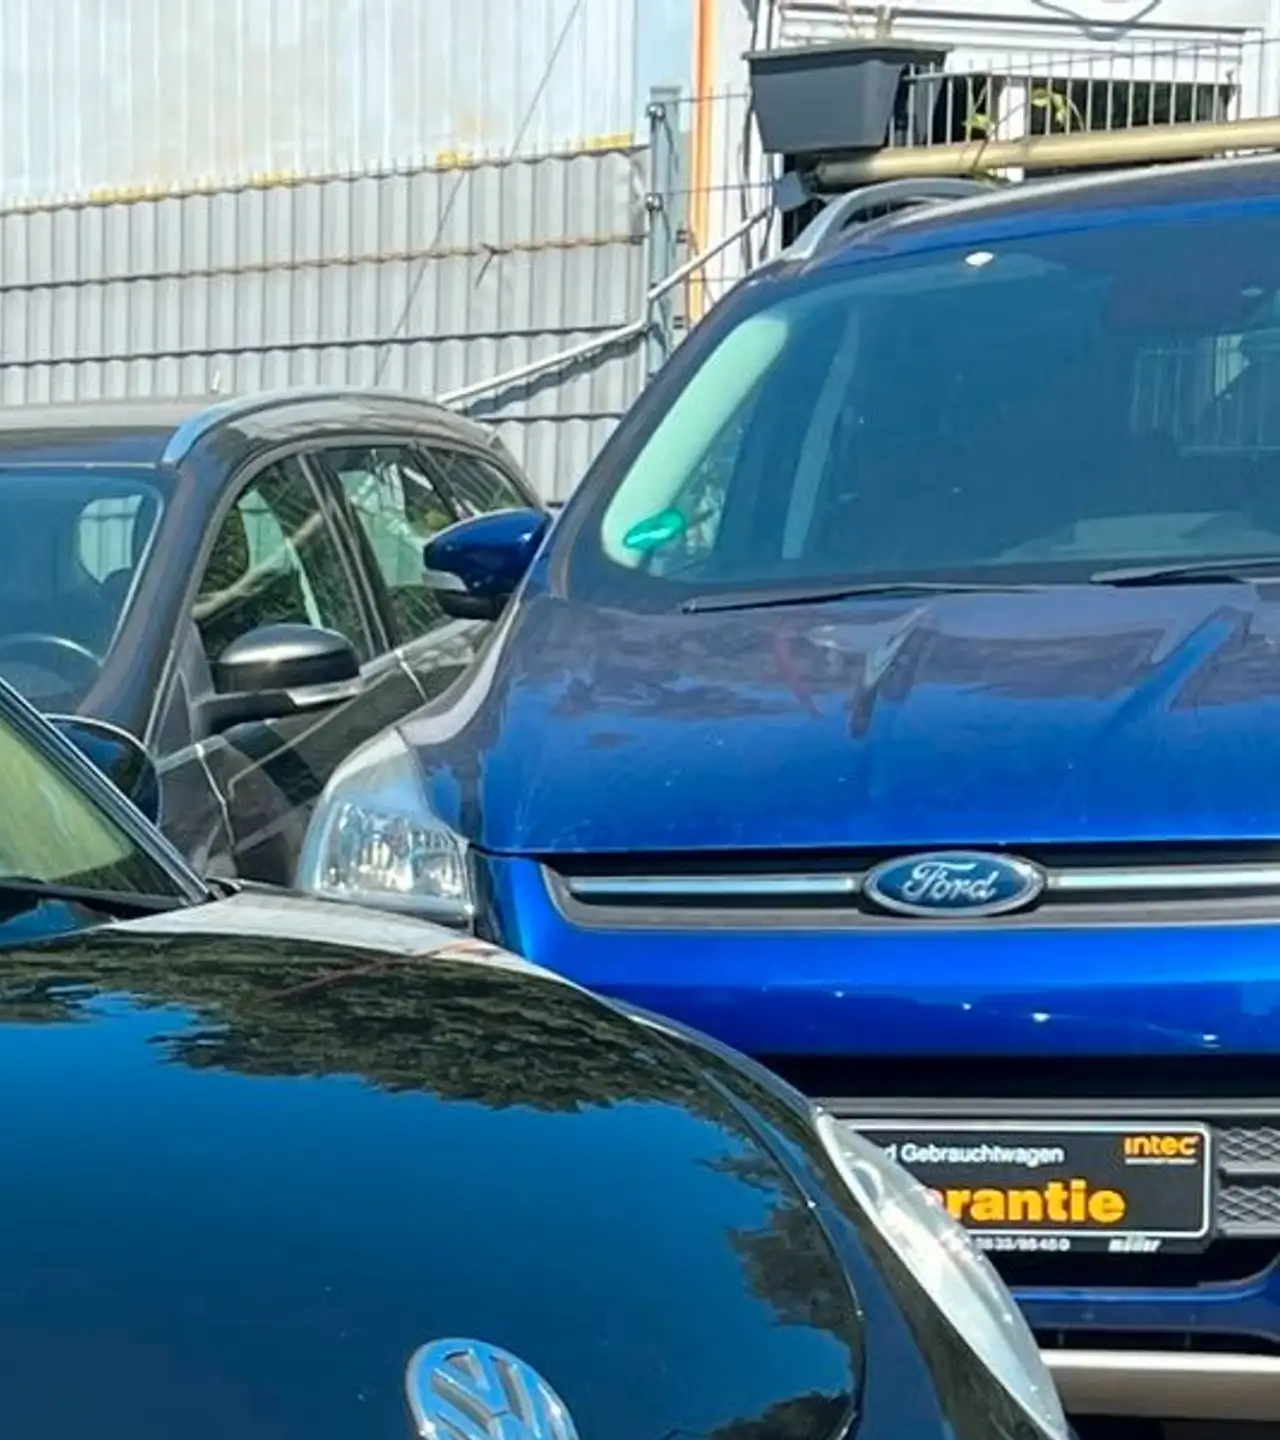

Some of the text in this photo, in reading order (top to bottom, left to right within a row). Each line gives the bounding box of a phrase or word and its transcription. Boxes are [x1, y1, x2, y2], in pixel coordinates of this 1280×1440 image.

[901, 860, 1000, 902] Ford
[900, 1142, 1066, 1168] Gebrauchtwagen
[1123, 1134, 1199, 1156] intec
